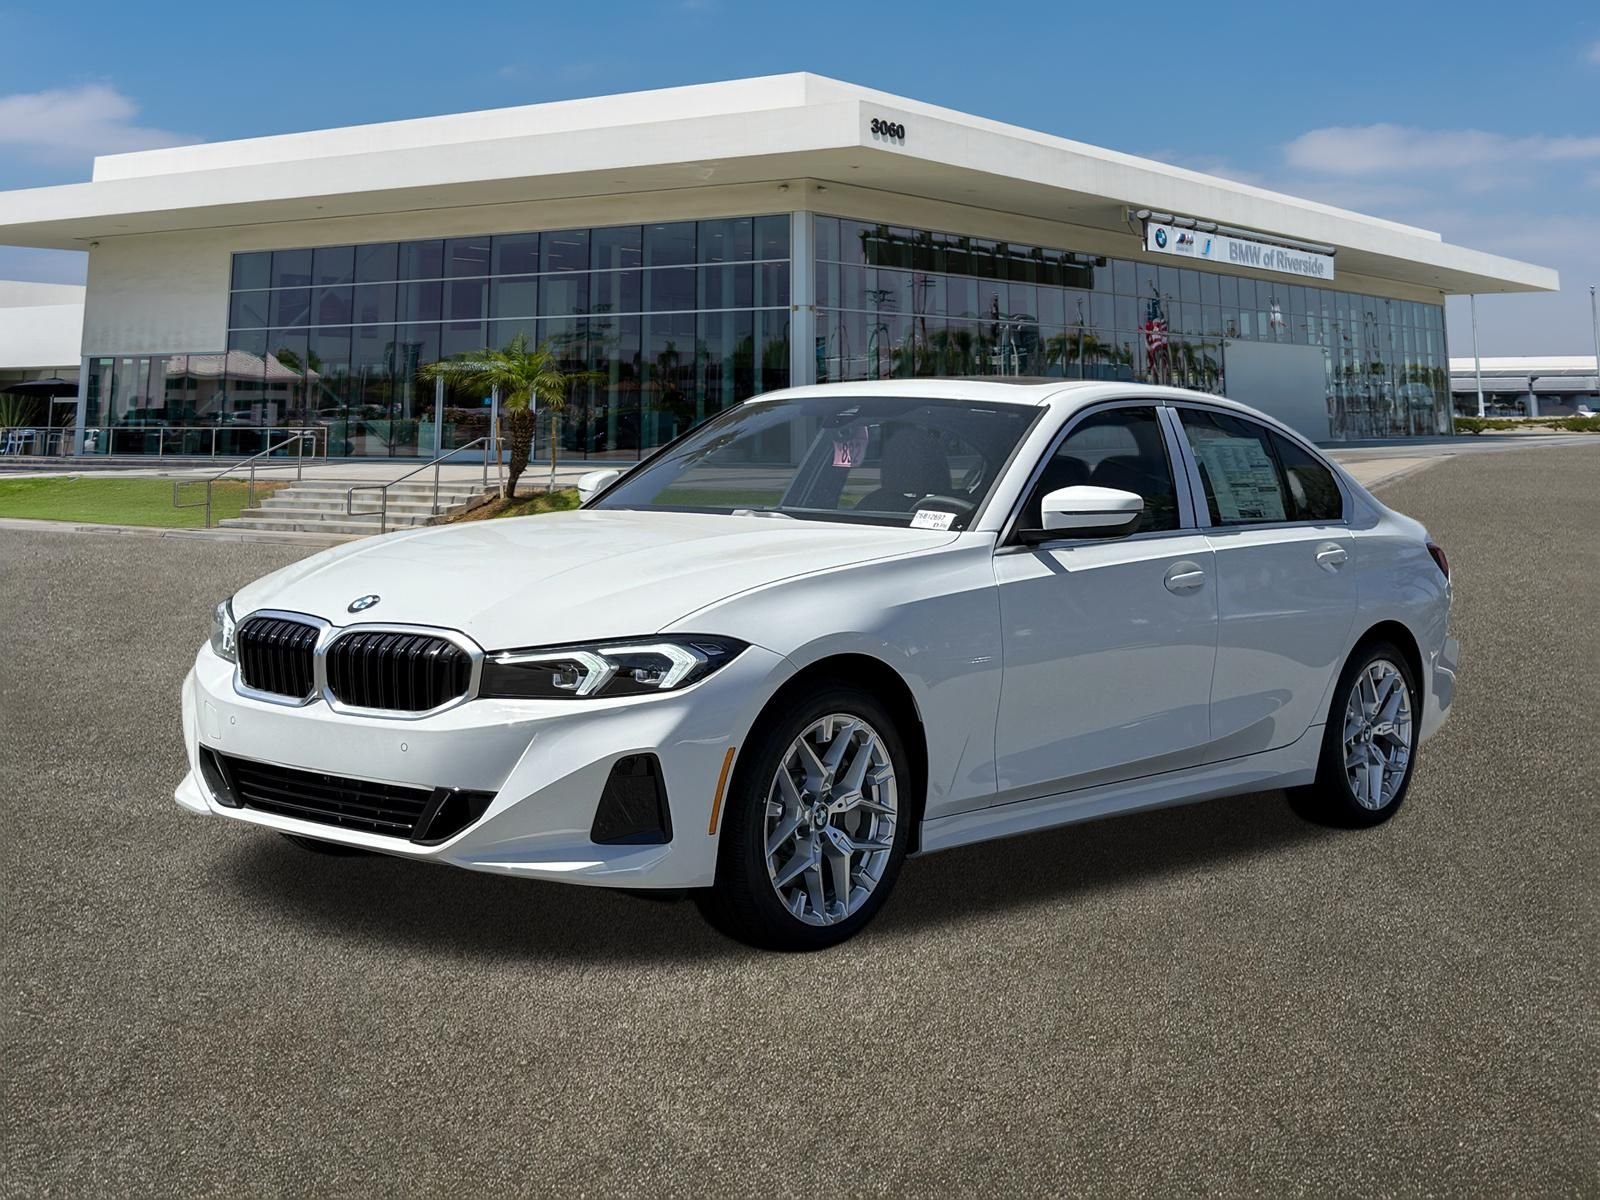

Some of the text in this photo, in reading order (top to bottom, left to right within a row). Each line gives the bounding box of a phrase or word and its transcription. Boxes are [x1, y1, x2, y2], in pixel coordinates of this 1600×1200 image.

[871, 118, 905, 139] 3060
[1229, 241, 1324, 275] BMW of Riverside
